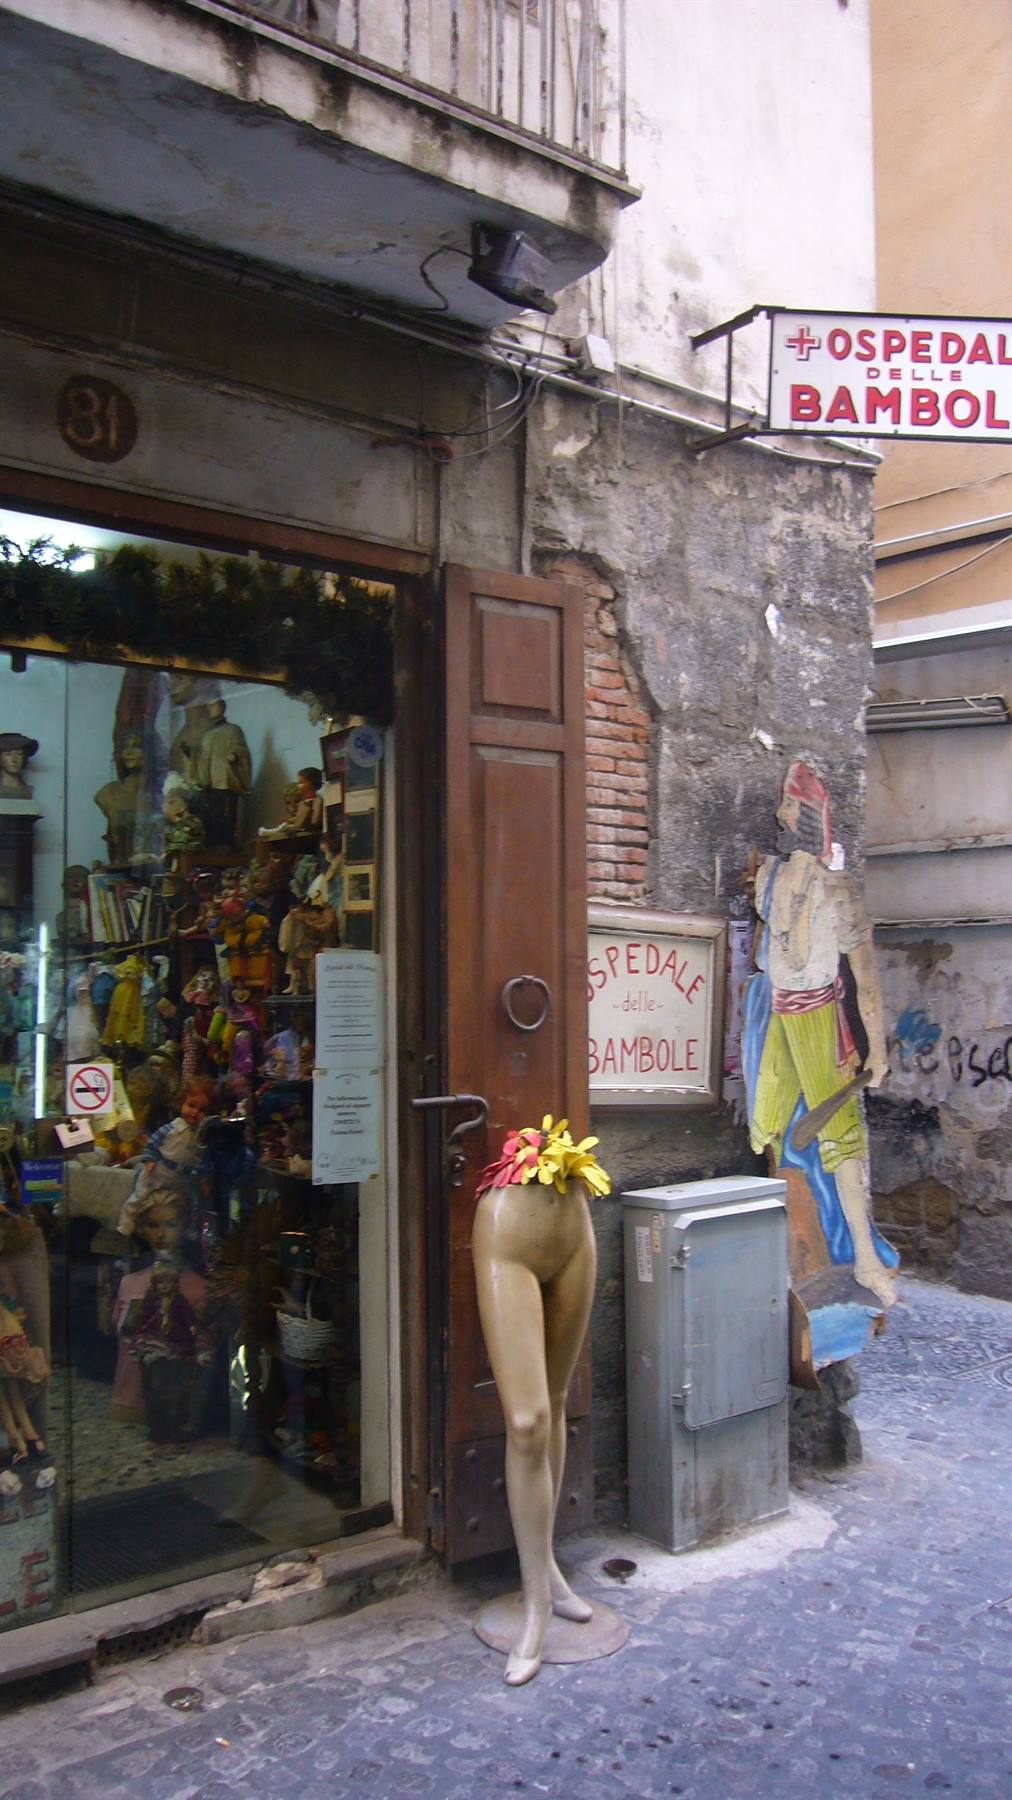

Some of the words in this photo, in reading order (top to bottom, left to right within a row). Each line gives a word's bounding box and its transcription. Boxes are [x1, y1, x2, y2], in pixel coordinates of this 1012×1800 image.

[827, 328, 1012, 366] OSPEDAL
[867, 367, 962, 382] DELLE
[66, 387, 119, 451] 81
[790, 384, 1010, 429] BAMBOL
